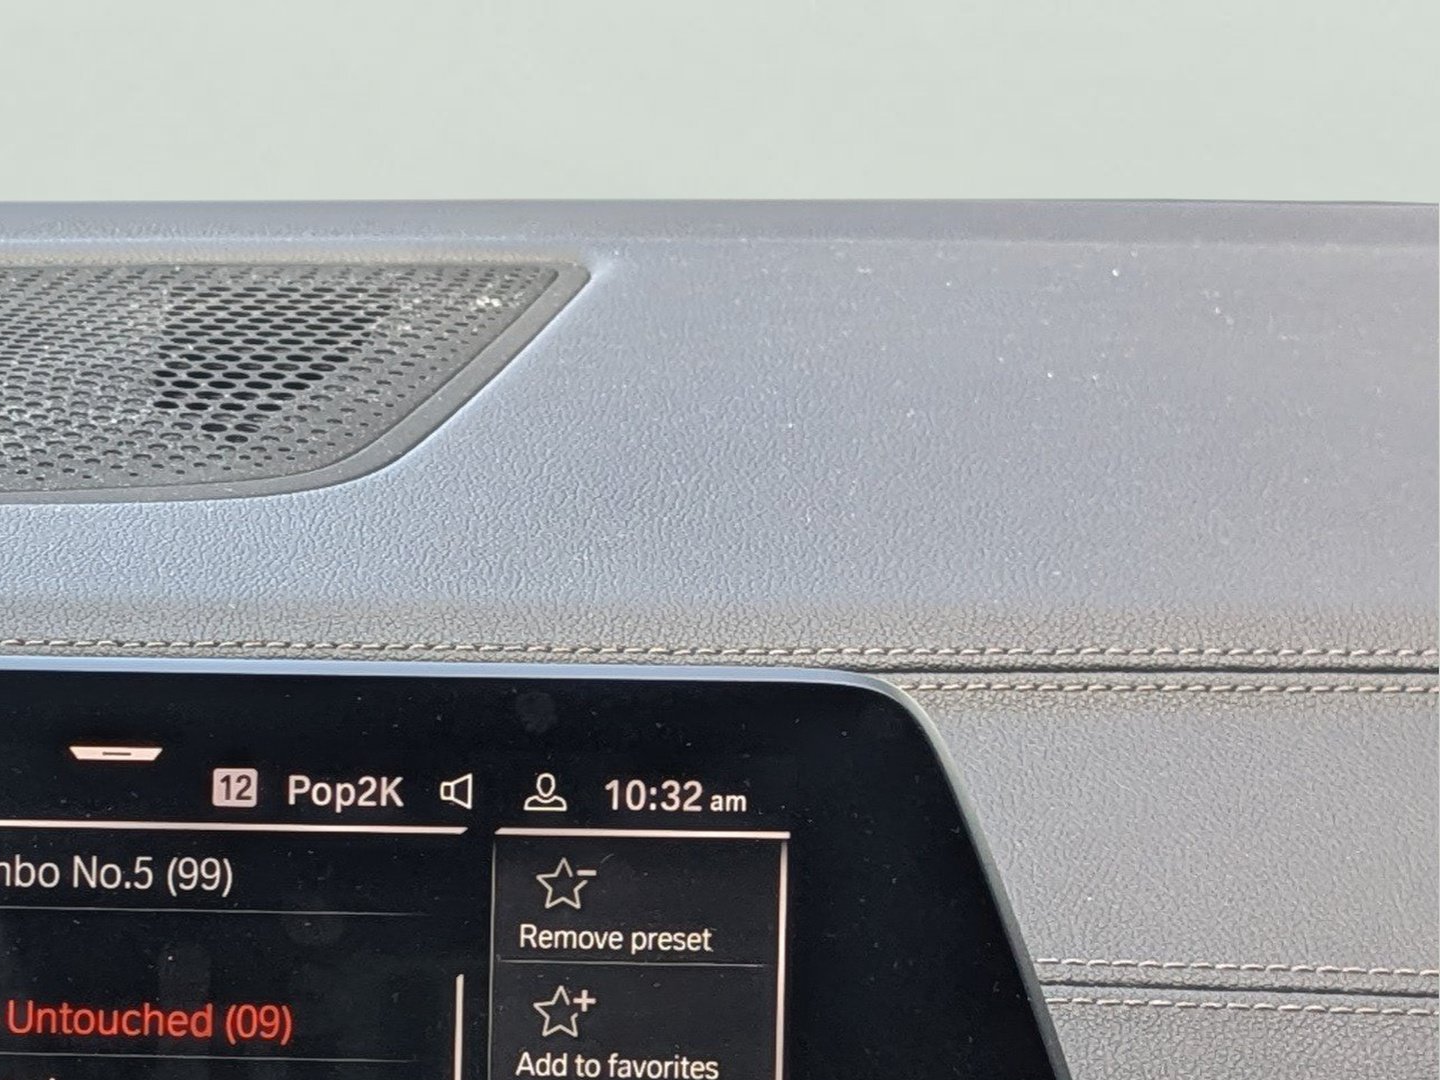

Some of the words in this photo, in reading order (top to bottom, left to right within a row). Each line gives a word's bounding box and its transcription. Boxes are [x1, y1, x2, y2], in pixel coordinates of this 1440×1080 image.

[219, 776, 252, 801] 12
[287, 775, 404, 813] Pop2K
[604, 780, 702, 811] 10:32
[710, 793, 747, 812] am
[71, 855, 153, 890] No.5
[166, 856, 233, 897] (99)
[519, 923, 623, 950] Remove
[631, 928, 713, 955] preset
[7, 999, 214, 1038] Untouched
[224, 1004, 294, 1045] (09)
[515, 1052, 567, 1076] Add
[575, 1055, 601, 1078] to
[608, 1053, 720, 1080] favorites
